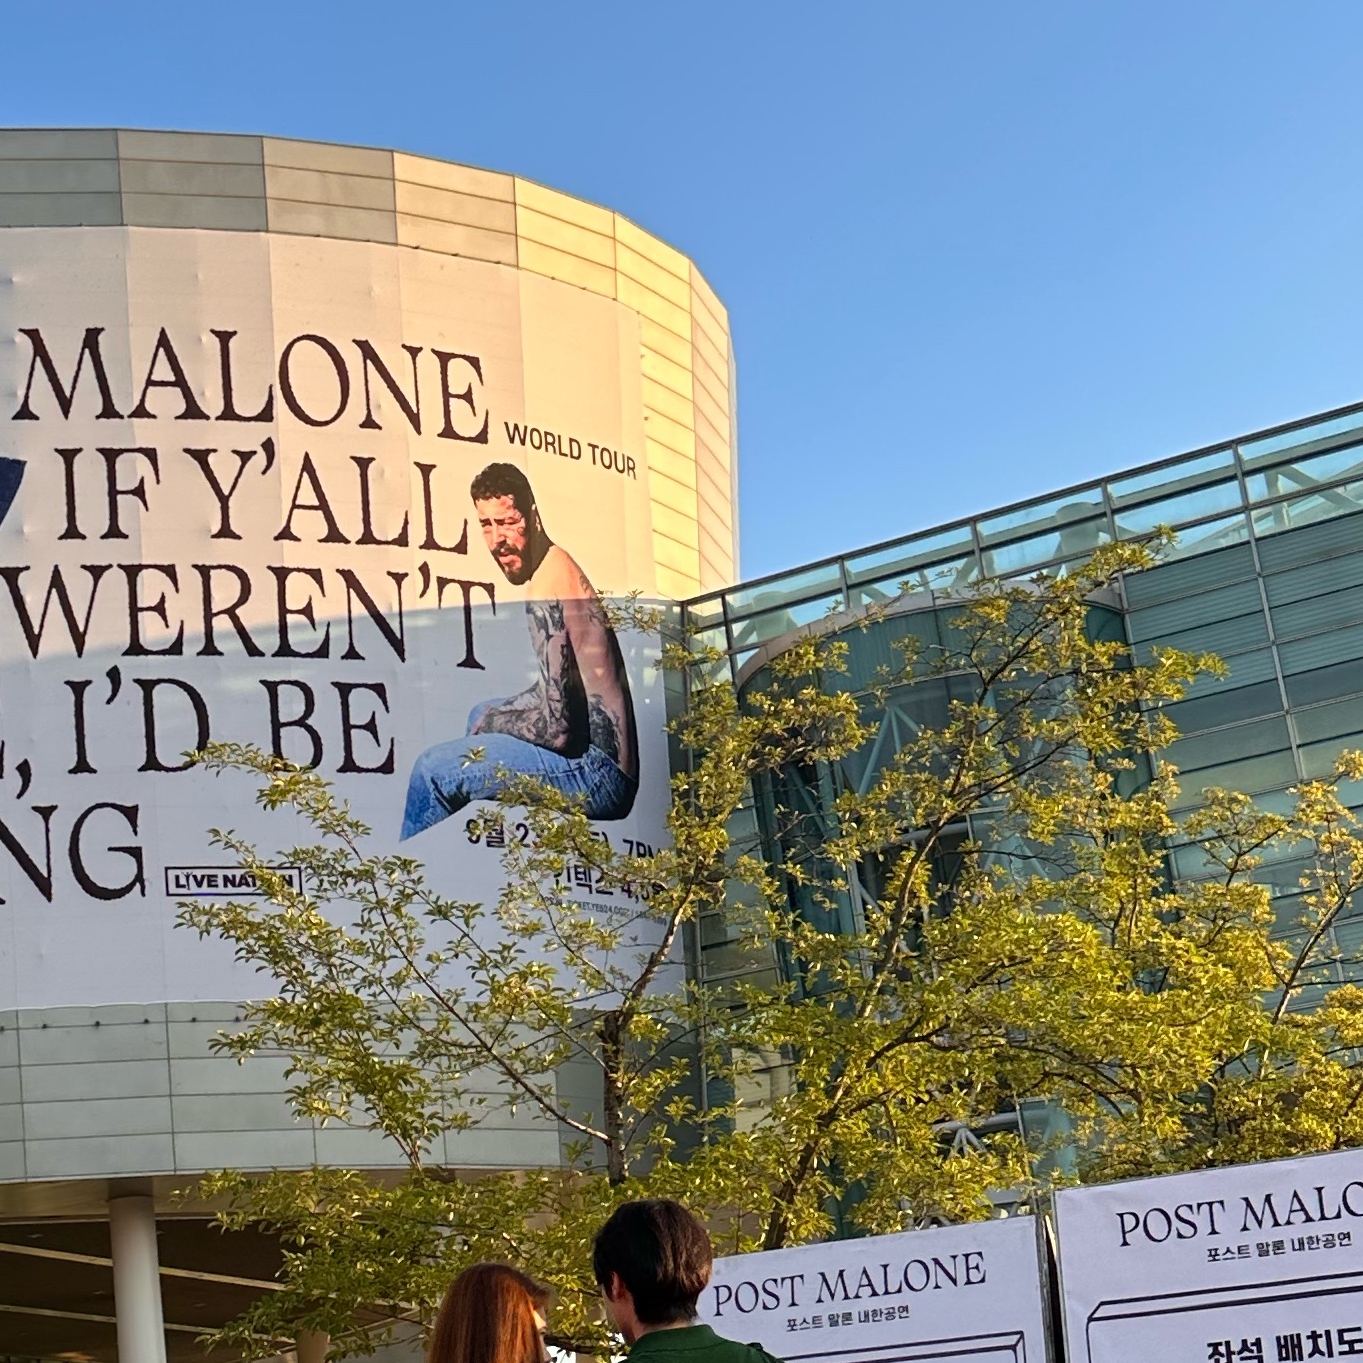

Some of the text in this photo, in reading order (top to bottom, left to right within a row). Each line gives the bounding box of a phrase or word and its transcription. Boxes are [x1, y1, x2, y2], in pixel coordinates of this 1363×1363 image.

[11, 327, 490, 445] MALONE
[504, 421, 638, 481] WORLD TOUR
[54, 436, 469, 556] IF Y'ALL
[66, 665, 209, 774] I'D
[260, 680, 396, 775] BE
[175, 872, 294, 890] LIVE NATN
[1116, 1199, 1226, 1247] POST
[1207, 1232, 1353, 1263] 포스트 말론 내한공연
[712, 1251, 987, 1317] POST MALONE
[786, 1304, 910, 1332] 포스트 말론 내한공연
[1275, 1327, 1363, 1363] 배치도
